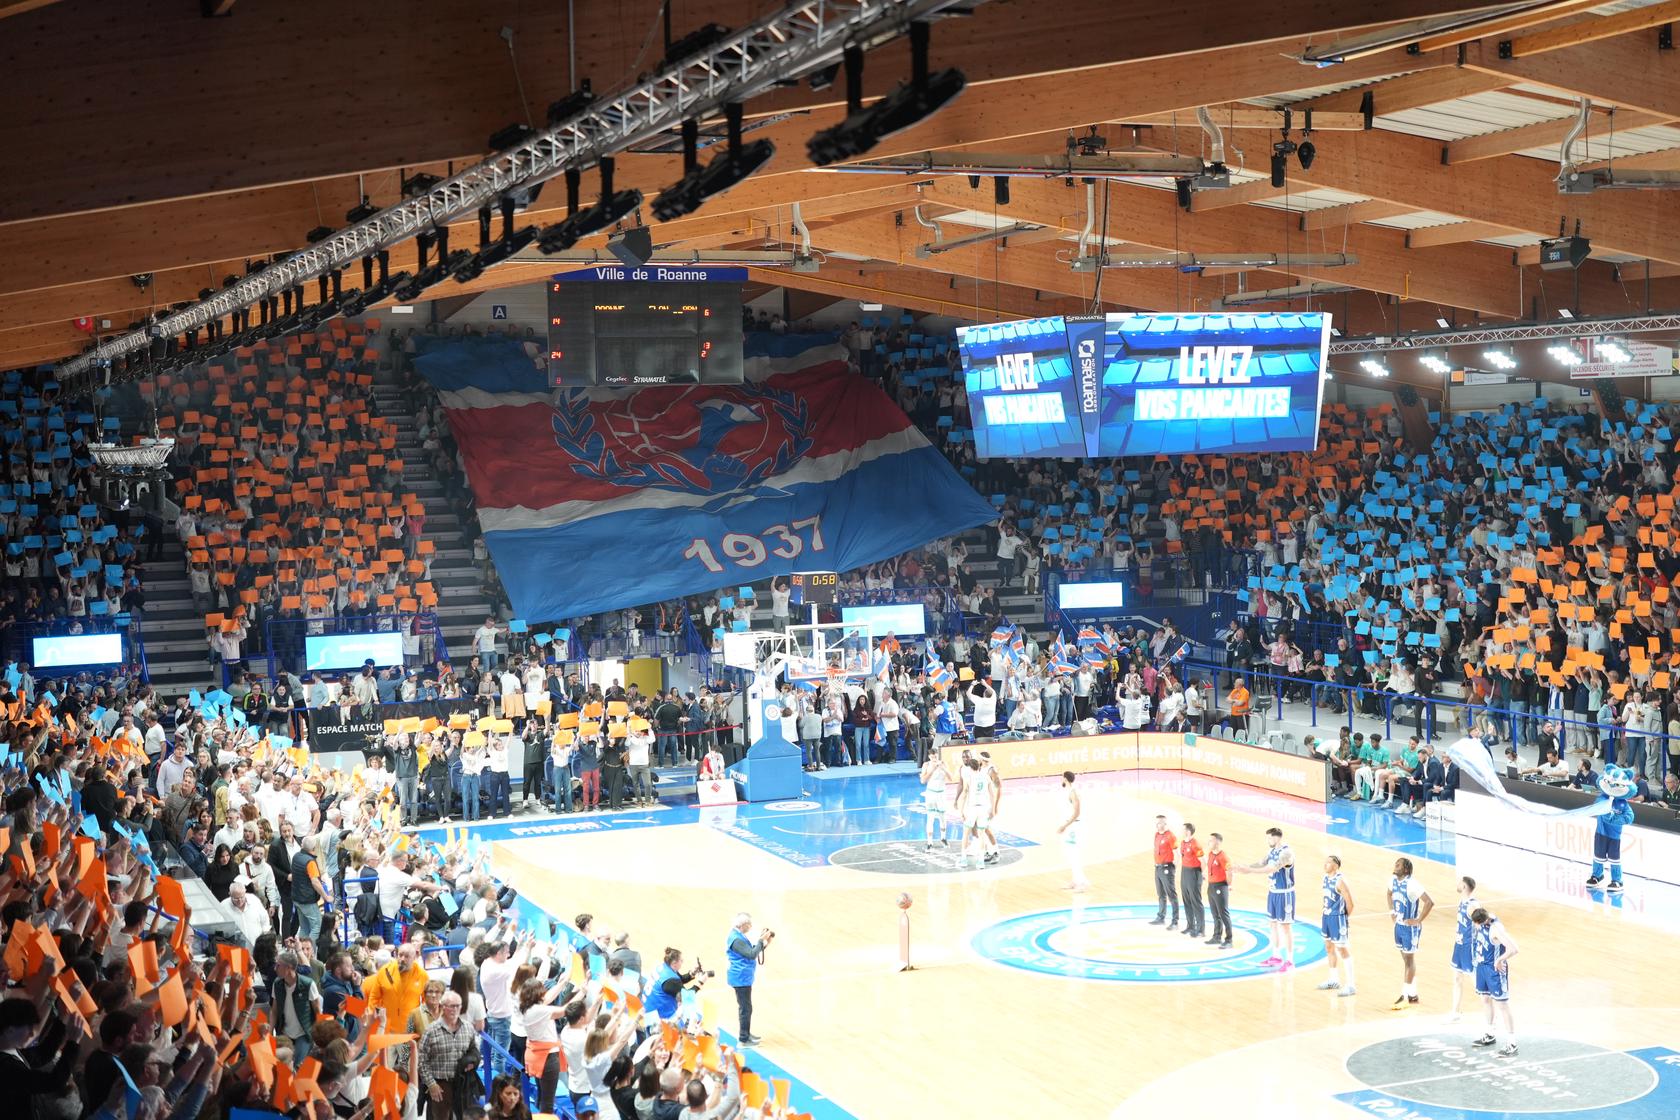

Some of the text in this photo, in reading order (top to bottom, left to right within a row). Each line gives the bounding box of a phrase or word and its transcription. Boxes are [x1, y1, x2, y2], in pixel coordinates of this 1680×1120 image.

[596, 268, 707, 280] Ville de Roanne
[495, 306, 505, 318] A
[996, 353, 1038, 390] LEVEZ
[1178, 345, 1254, 384] LEVEZ
[1081, 358, 1094, 413] roannais
[1138, 391, 1176, 419] VOS
[684, 513, 824, 572] 1937
[812, 574, 836, 586] 0:58
[317, 723, 383, 734] ESPACE MATCH
[1049, 747, 1089, 766] UNITÉ
[1545, 821, 1644, 860] FORMI
